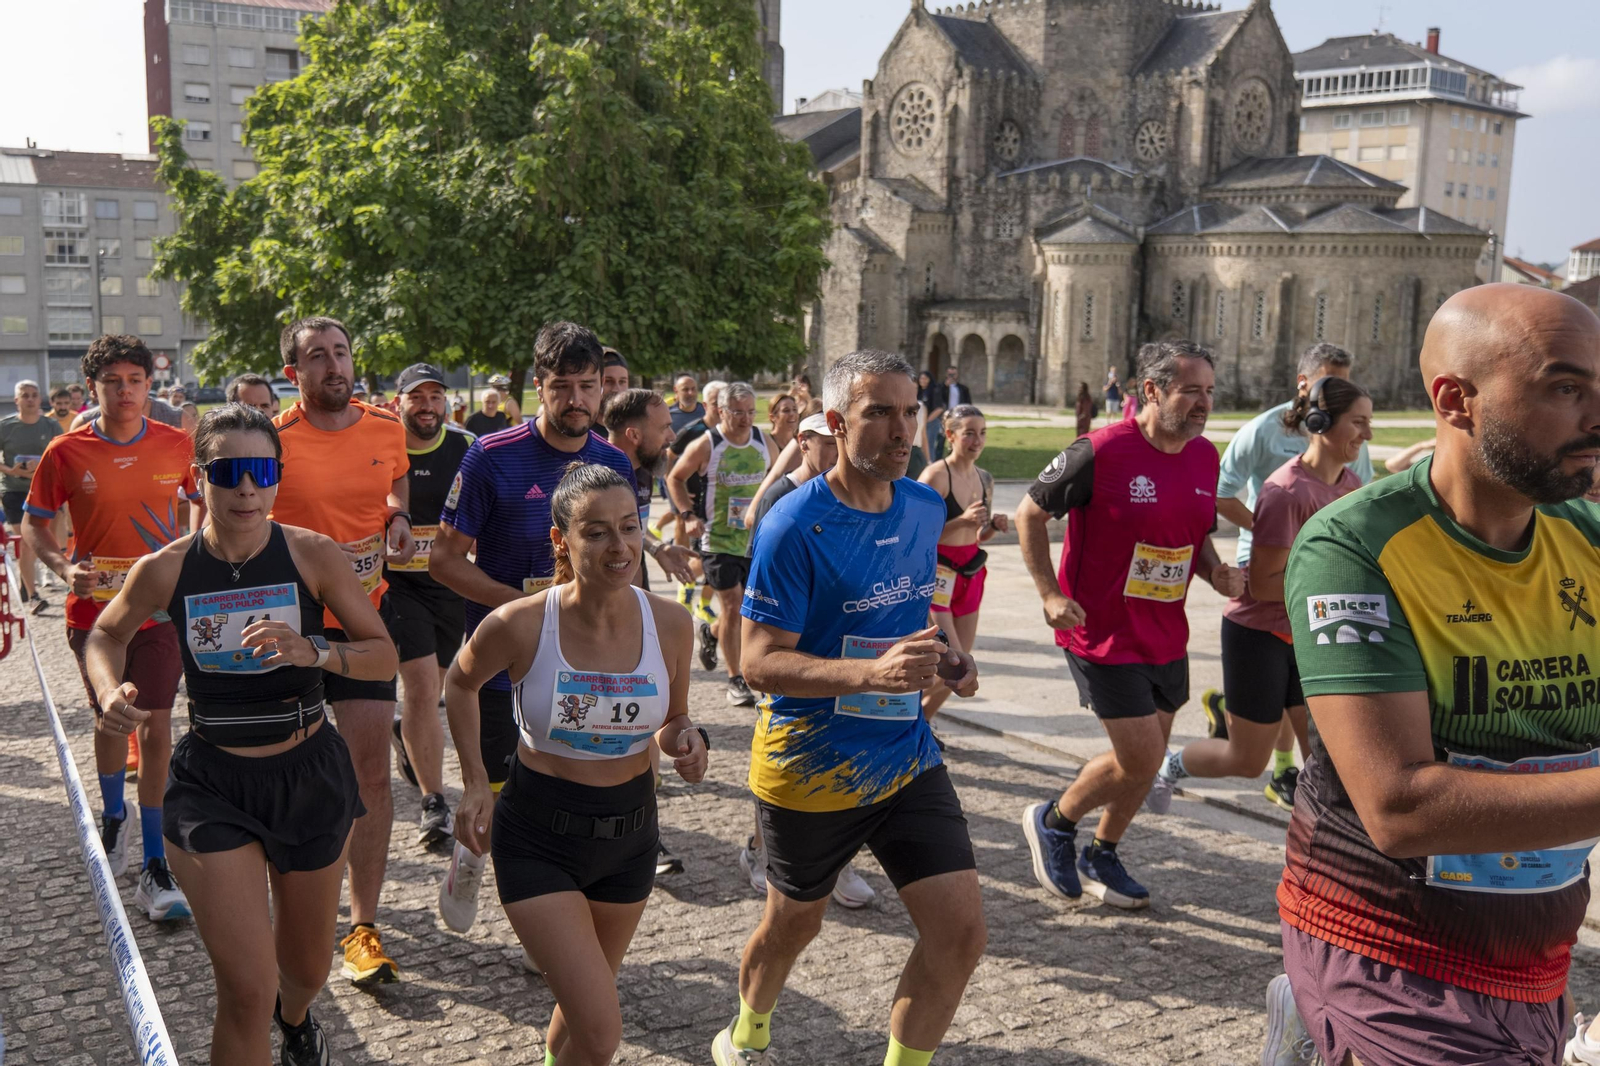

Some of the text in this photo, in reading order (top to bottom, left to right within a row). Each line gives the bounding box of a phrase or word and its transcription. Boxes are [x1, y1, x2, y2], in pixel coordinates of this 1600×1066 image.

[525, 492, 546, 500] adidas
[354, 553, 379, 573] 359
[1160, 564, 1184, 579] 376
[873, 576, 911, 595] CLUB
[201, 593, 246, 605] CARREIRA
[247, 587, 289, 599] POPULAR
[219, 598, 265, 610] DO PULPO
[1329, 599, 1380, 611] alcer
[1496, 653, 1591, 682] CARRERA
[572, 674, 618, 685] CARREIRA
[1453, 655, 1489, 715] II
[590, 684, 634, 694] DO PULPO
[610, 702, 640, 723] 19
[1439, 871, 1473, 882] GADIS
